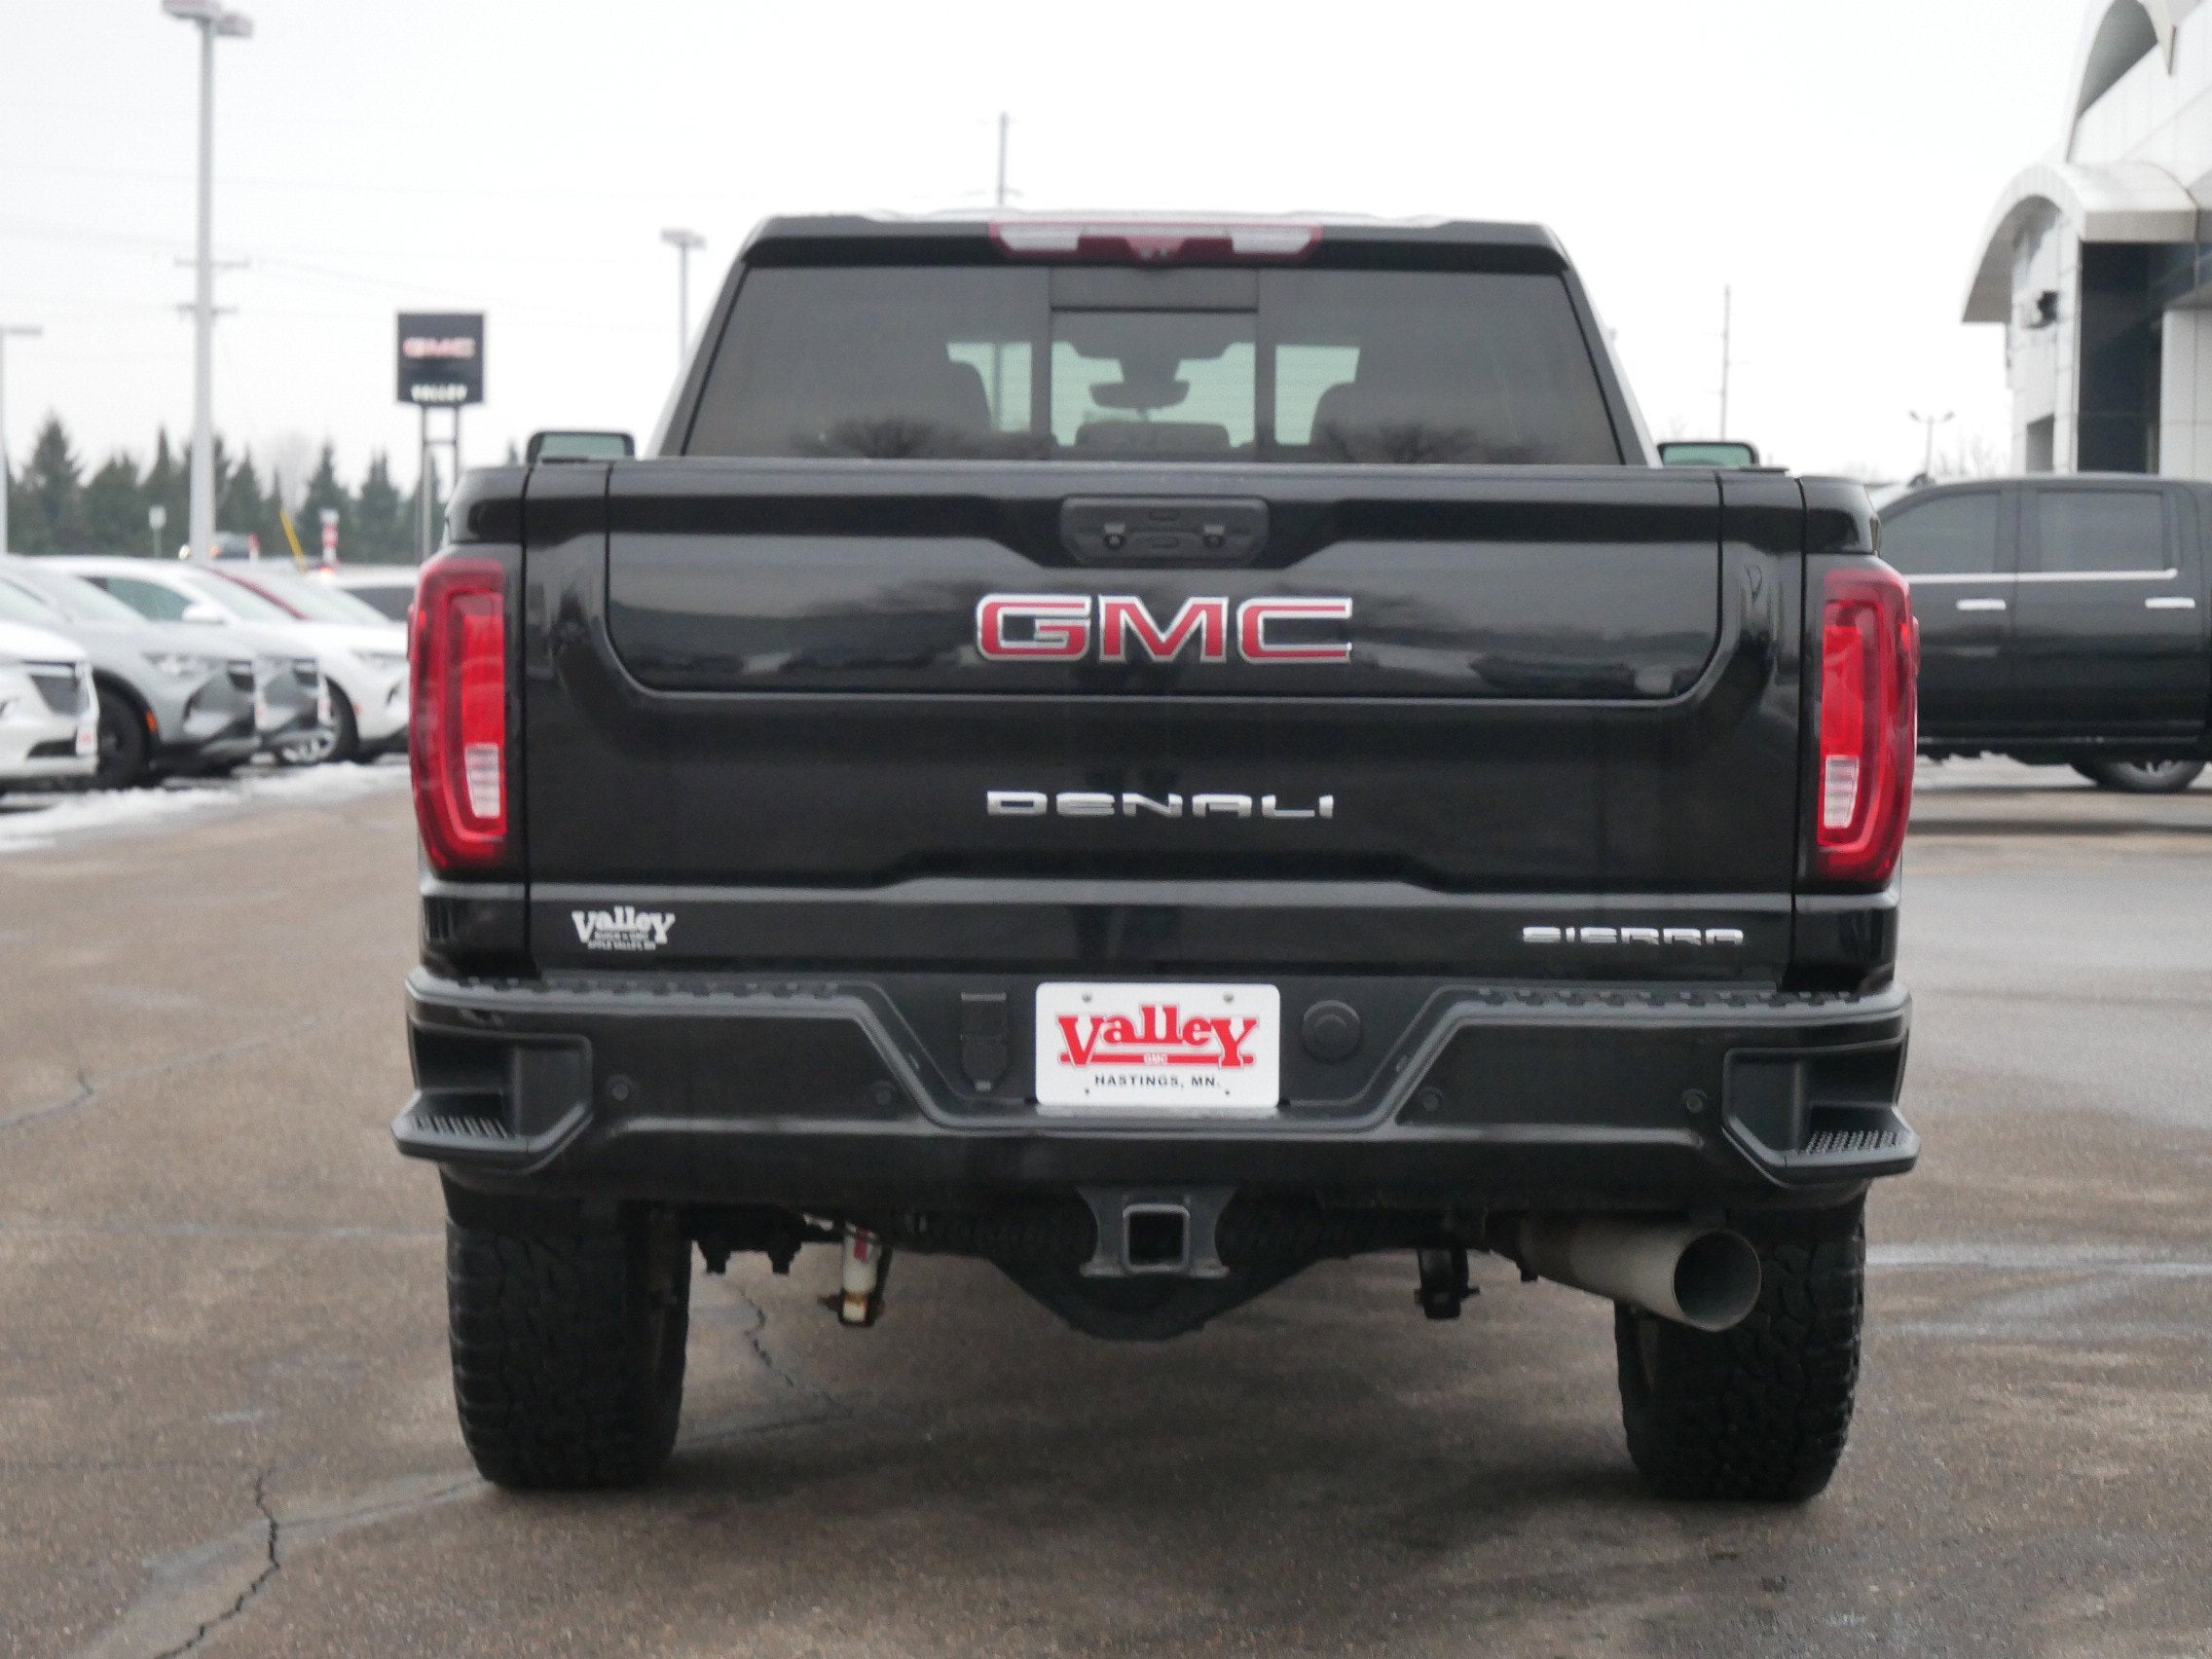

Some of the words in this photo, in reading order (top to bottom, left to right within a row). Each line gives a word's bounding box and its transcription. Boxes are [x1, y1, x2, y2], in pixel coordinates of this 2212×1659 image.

[977, 593, 1353, 664] GMC
[985, 790, 1335, 819] DENALI
[1522, 925, 1745, 945] SIERRA
[1094, 1074, 1185, 1088] HASTINGS,
